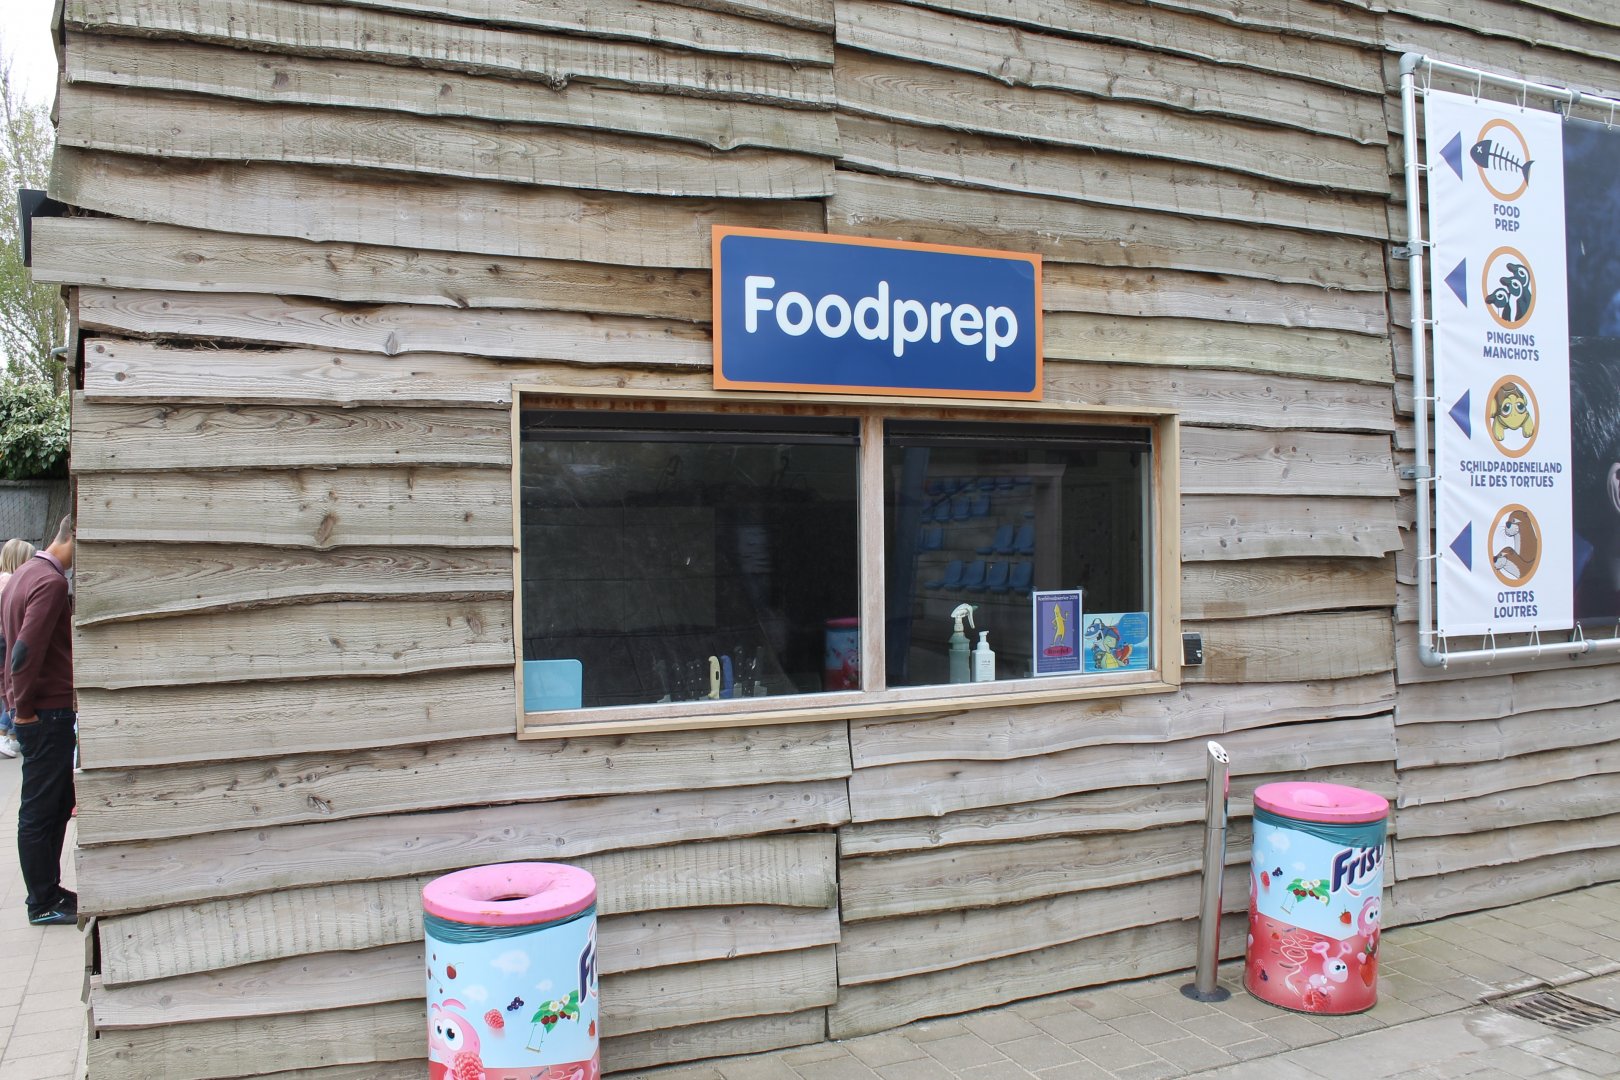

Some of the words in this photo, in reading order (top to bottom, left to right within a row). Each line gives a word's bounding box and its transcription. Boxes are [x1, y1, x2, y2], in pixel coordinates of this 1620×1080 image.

[1493, 204, 1520, 218] FOOD
[1495, 218, 1520, 232] PREP
[745, 275, 1018, 362] Foodprep
[1486, 331, 1535, 346] PINGUINS
[1483, 345, 1540, 361] MANCHOTS
[1460, 460, 1562, 473] SCHILDPADDENEILAND
[1489, 474, 1507, 487] DES
[1510, 475, 1554, 488] TORTUES
[1497, 590, 1534, 603] OTTERS
[1494, 605, 1538, 618] LOUTRES
